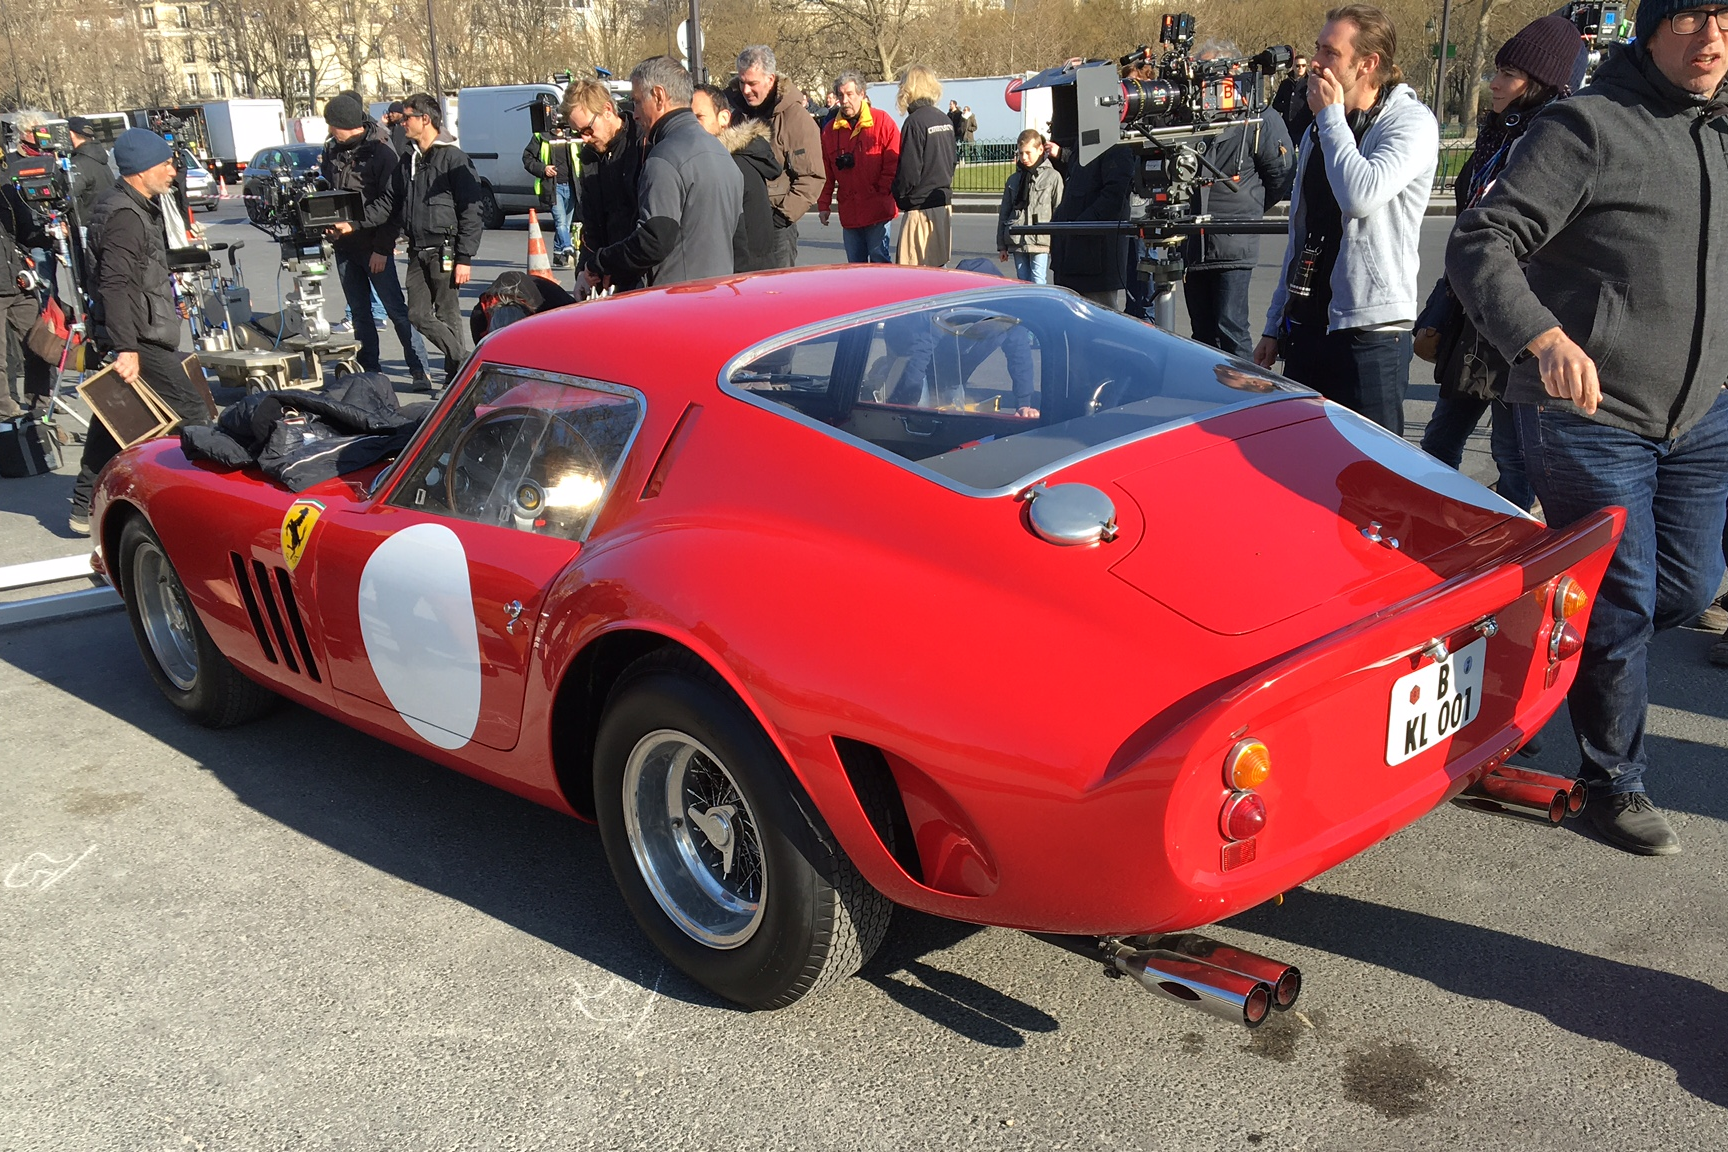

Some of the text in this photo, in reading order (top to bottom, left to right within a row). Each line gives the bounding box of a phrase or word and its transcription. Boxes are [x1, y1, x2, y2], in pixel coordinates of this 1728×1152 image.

[1224, 86, 1232, 98] B
[1437, 663, 1450, 700] B
[1404, 686, 1472, 755] KL 001
